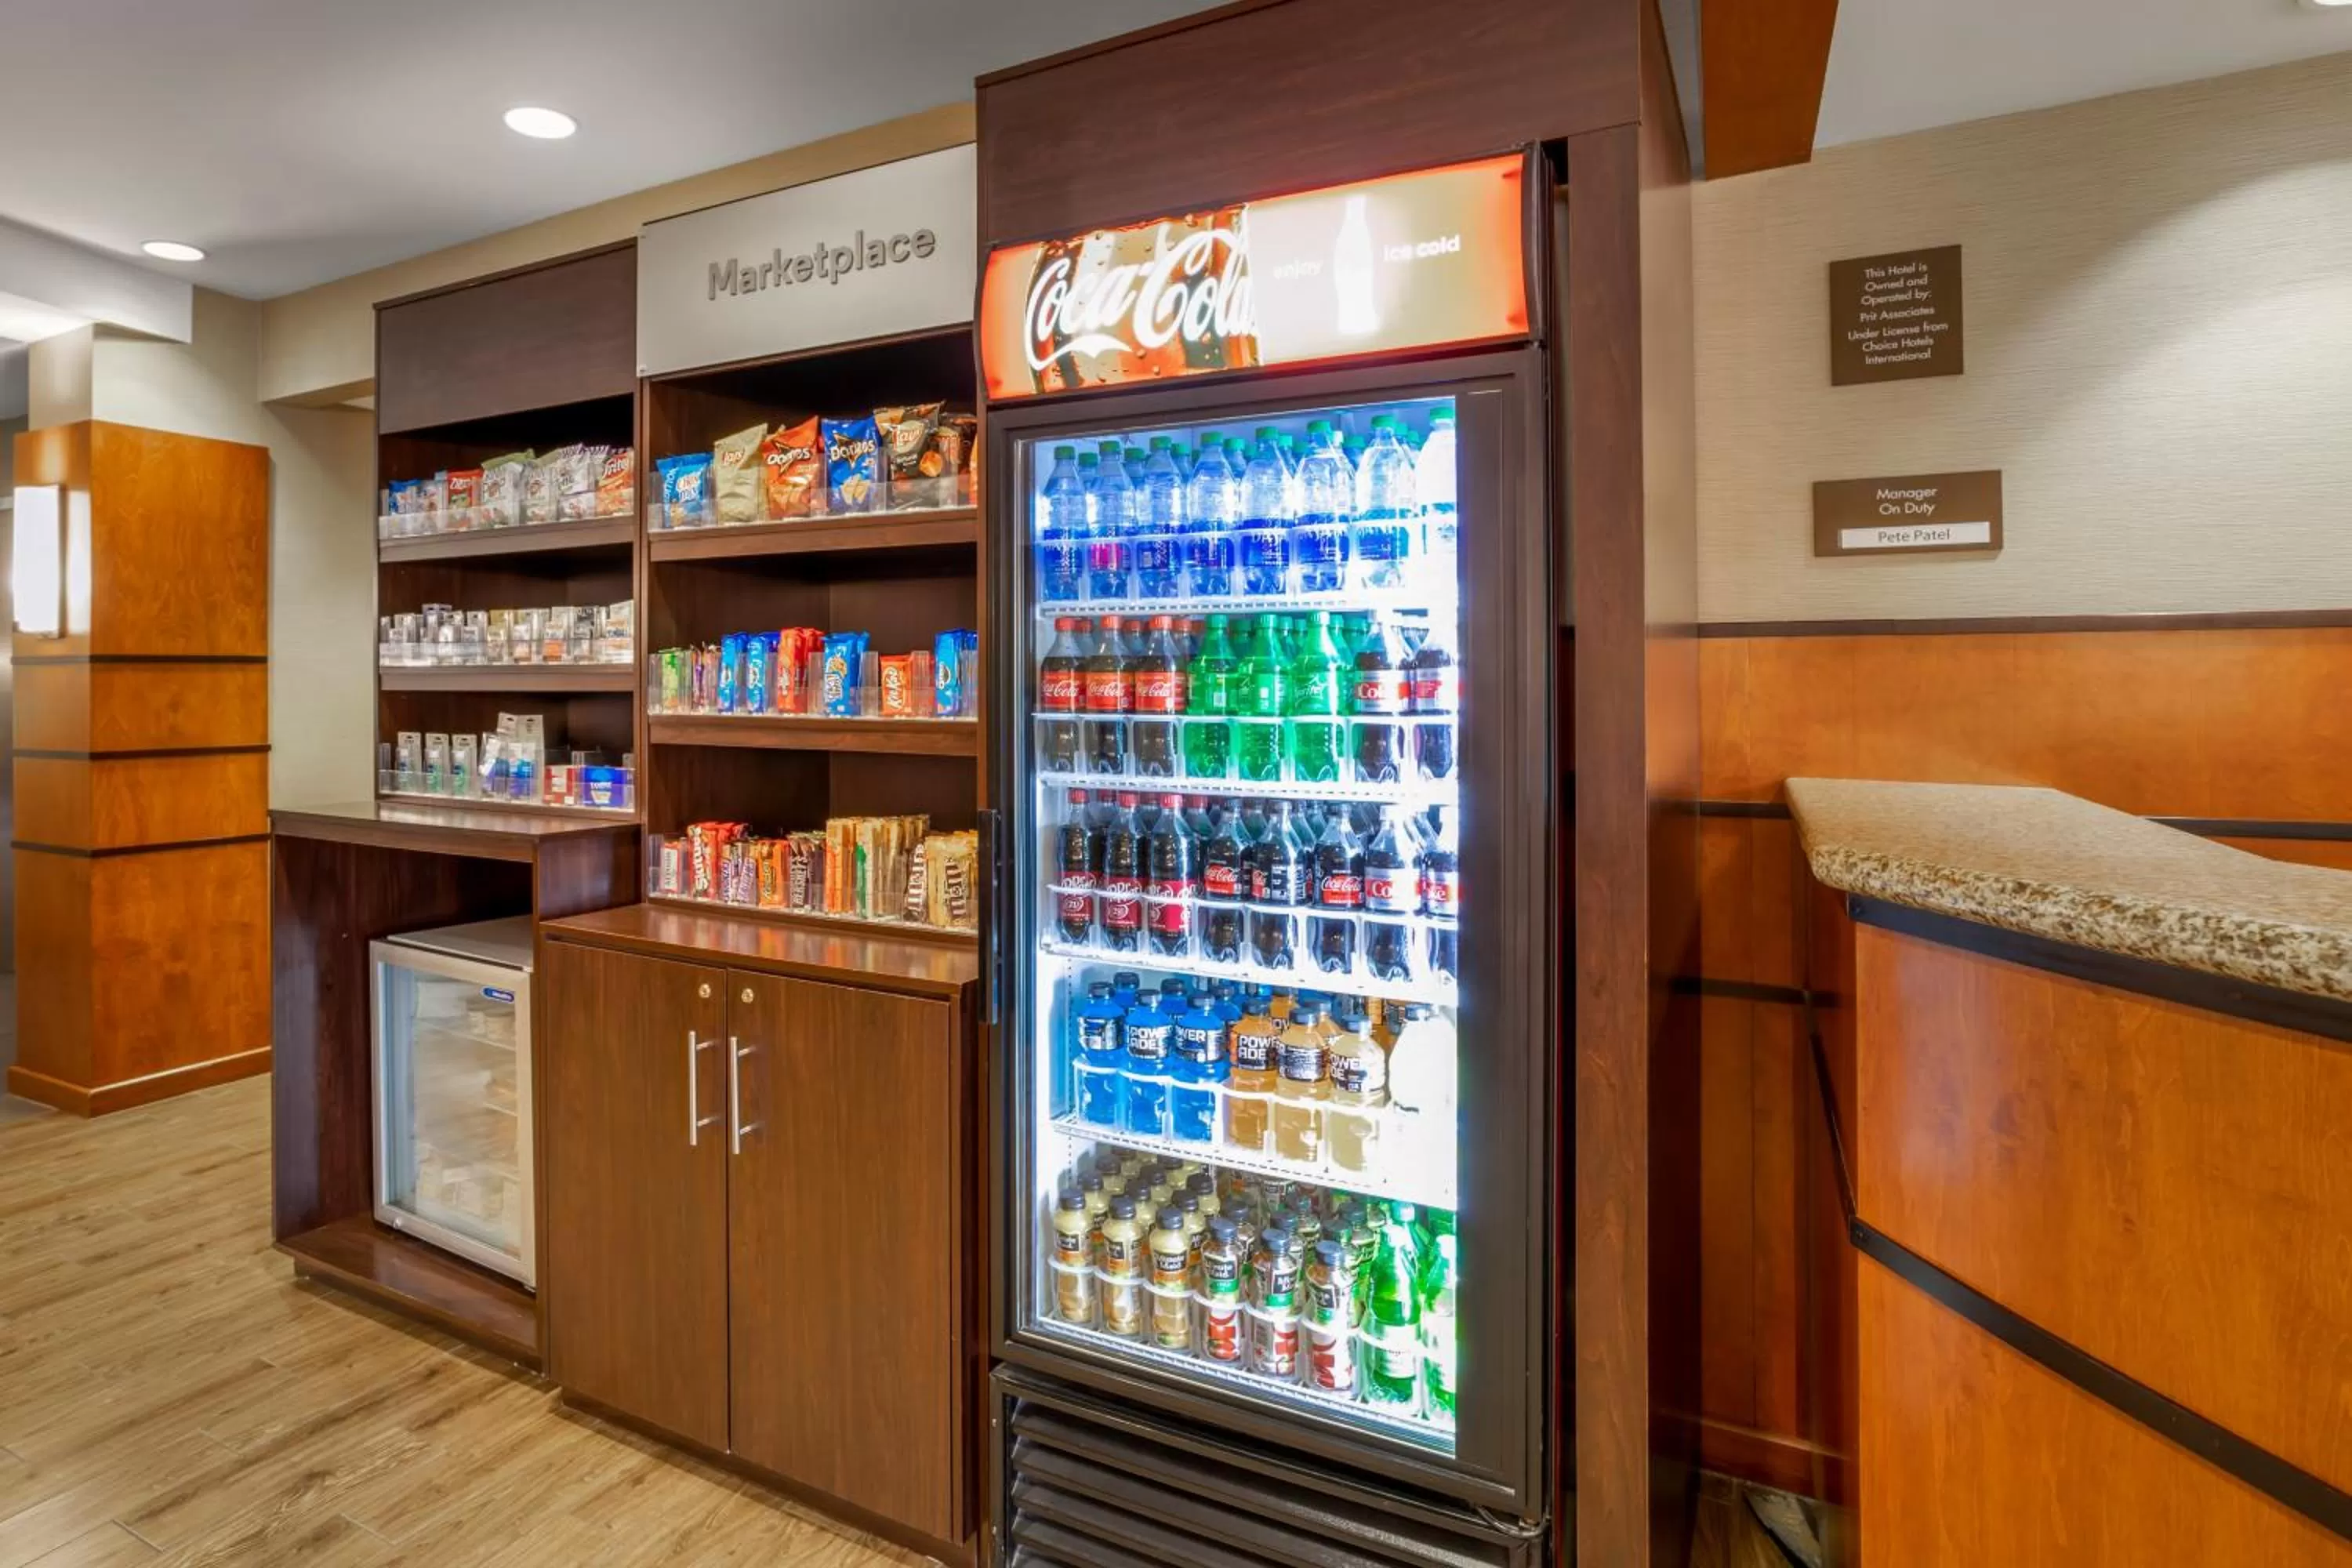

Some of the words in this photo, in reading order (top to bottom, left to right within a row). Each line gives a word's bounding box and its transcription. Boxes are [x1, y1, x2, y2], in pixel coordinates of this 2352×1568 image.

[1383, 244, 1411, 263] ice
[1416, 234, 1461, 257] cold
[707, 228, 936, 300] Marketplace
[1272, 256, 1323, 280] enjoy
[1864, 267, 1886, 279] This
[1888, 263, 1915, 276] Hotel
[1865, 277, 1904, 292] Owned
[1907, 274, 1929, 287] and
[1860, 290, 1912, 307] Operated
[1879, 307, 1936, 321] Associates
[1848, 328, 1880, 341] Under
[1882, 325, 1921, 337] License
[1923, 321, 1949, 332] from
[1862, 339, 1899, 352] Choice
[1901, 336, 1935, 349] Hotels
[1865, 347, 1932, 365] International
[1876, 488, 1938, 500] Manager
[1879, 503, 1900, 515] On
[1904, 502, 1936, 517] Duty
[1878, 531, 1910, 543] Pete
[1914, 528, 1951, 542] Patel
[1238, 1047, 1267, 1059] ADE
